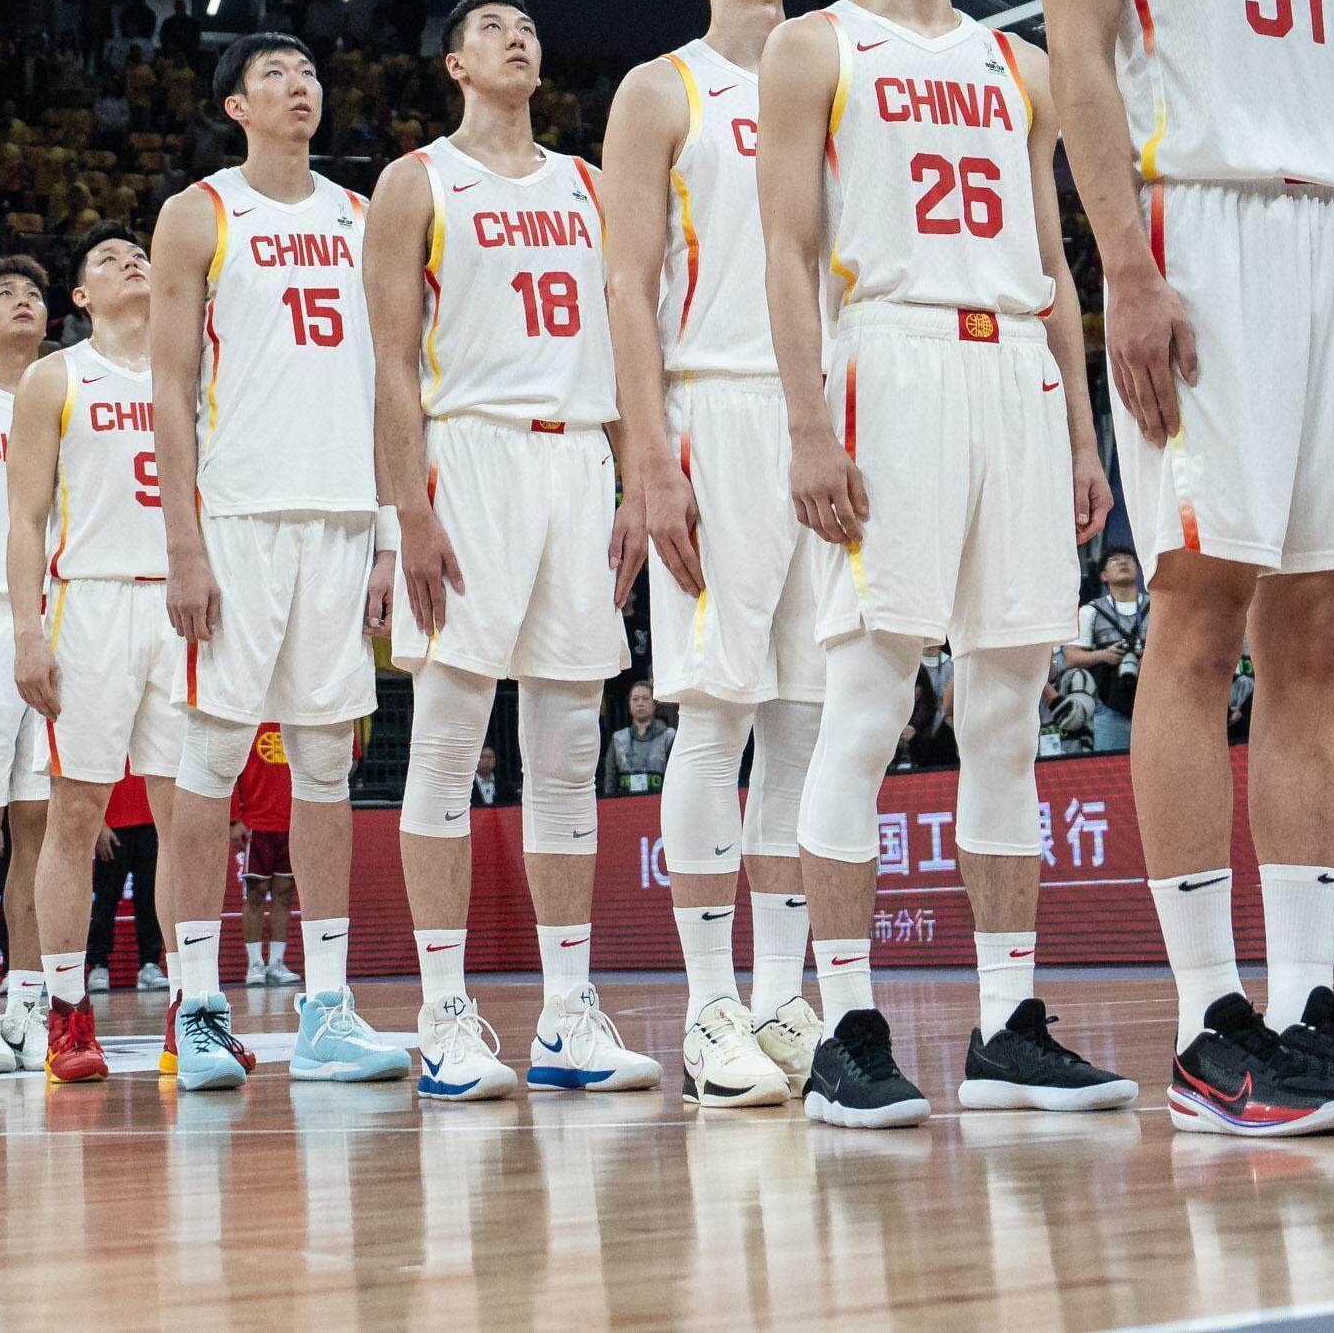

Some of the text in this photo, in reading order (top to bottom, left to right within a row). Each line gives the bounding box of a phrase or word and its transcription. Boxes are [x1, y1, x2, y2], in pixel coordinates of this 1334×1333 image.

[874, 77, 1013, 132] CHINA
[910, 153, 1003, 239] 26
[250, 233, 354, 268] CHINA
[473, 211, 592, 249] CHINA
[282, 287, 344, 347] 15
[511, 271, 581, 337] 18
